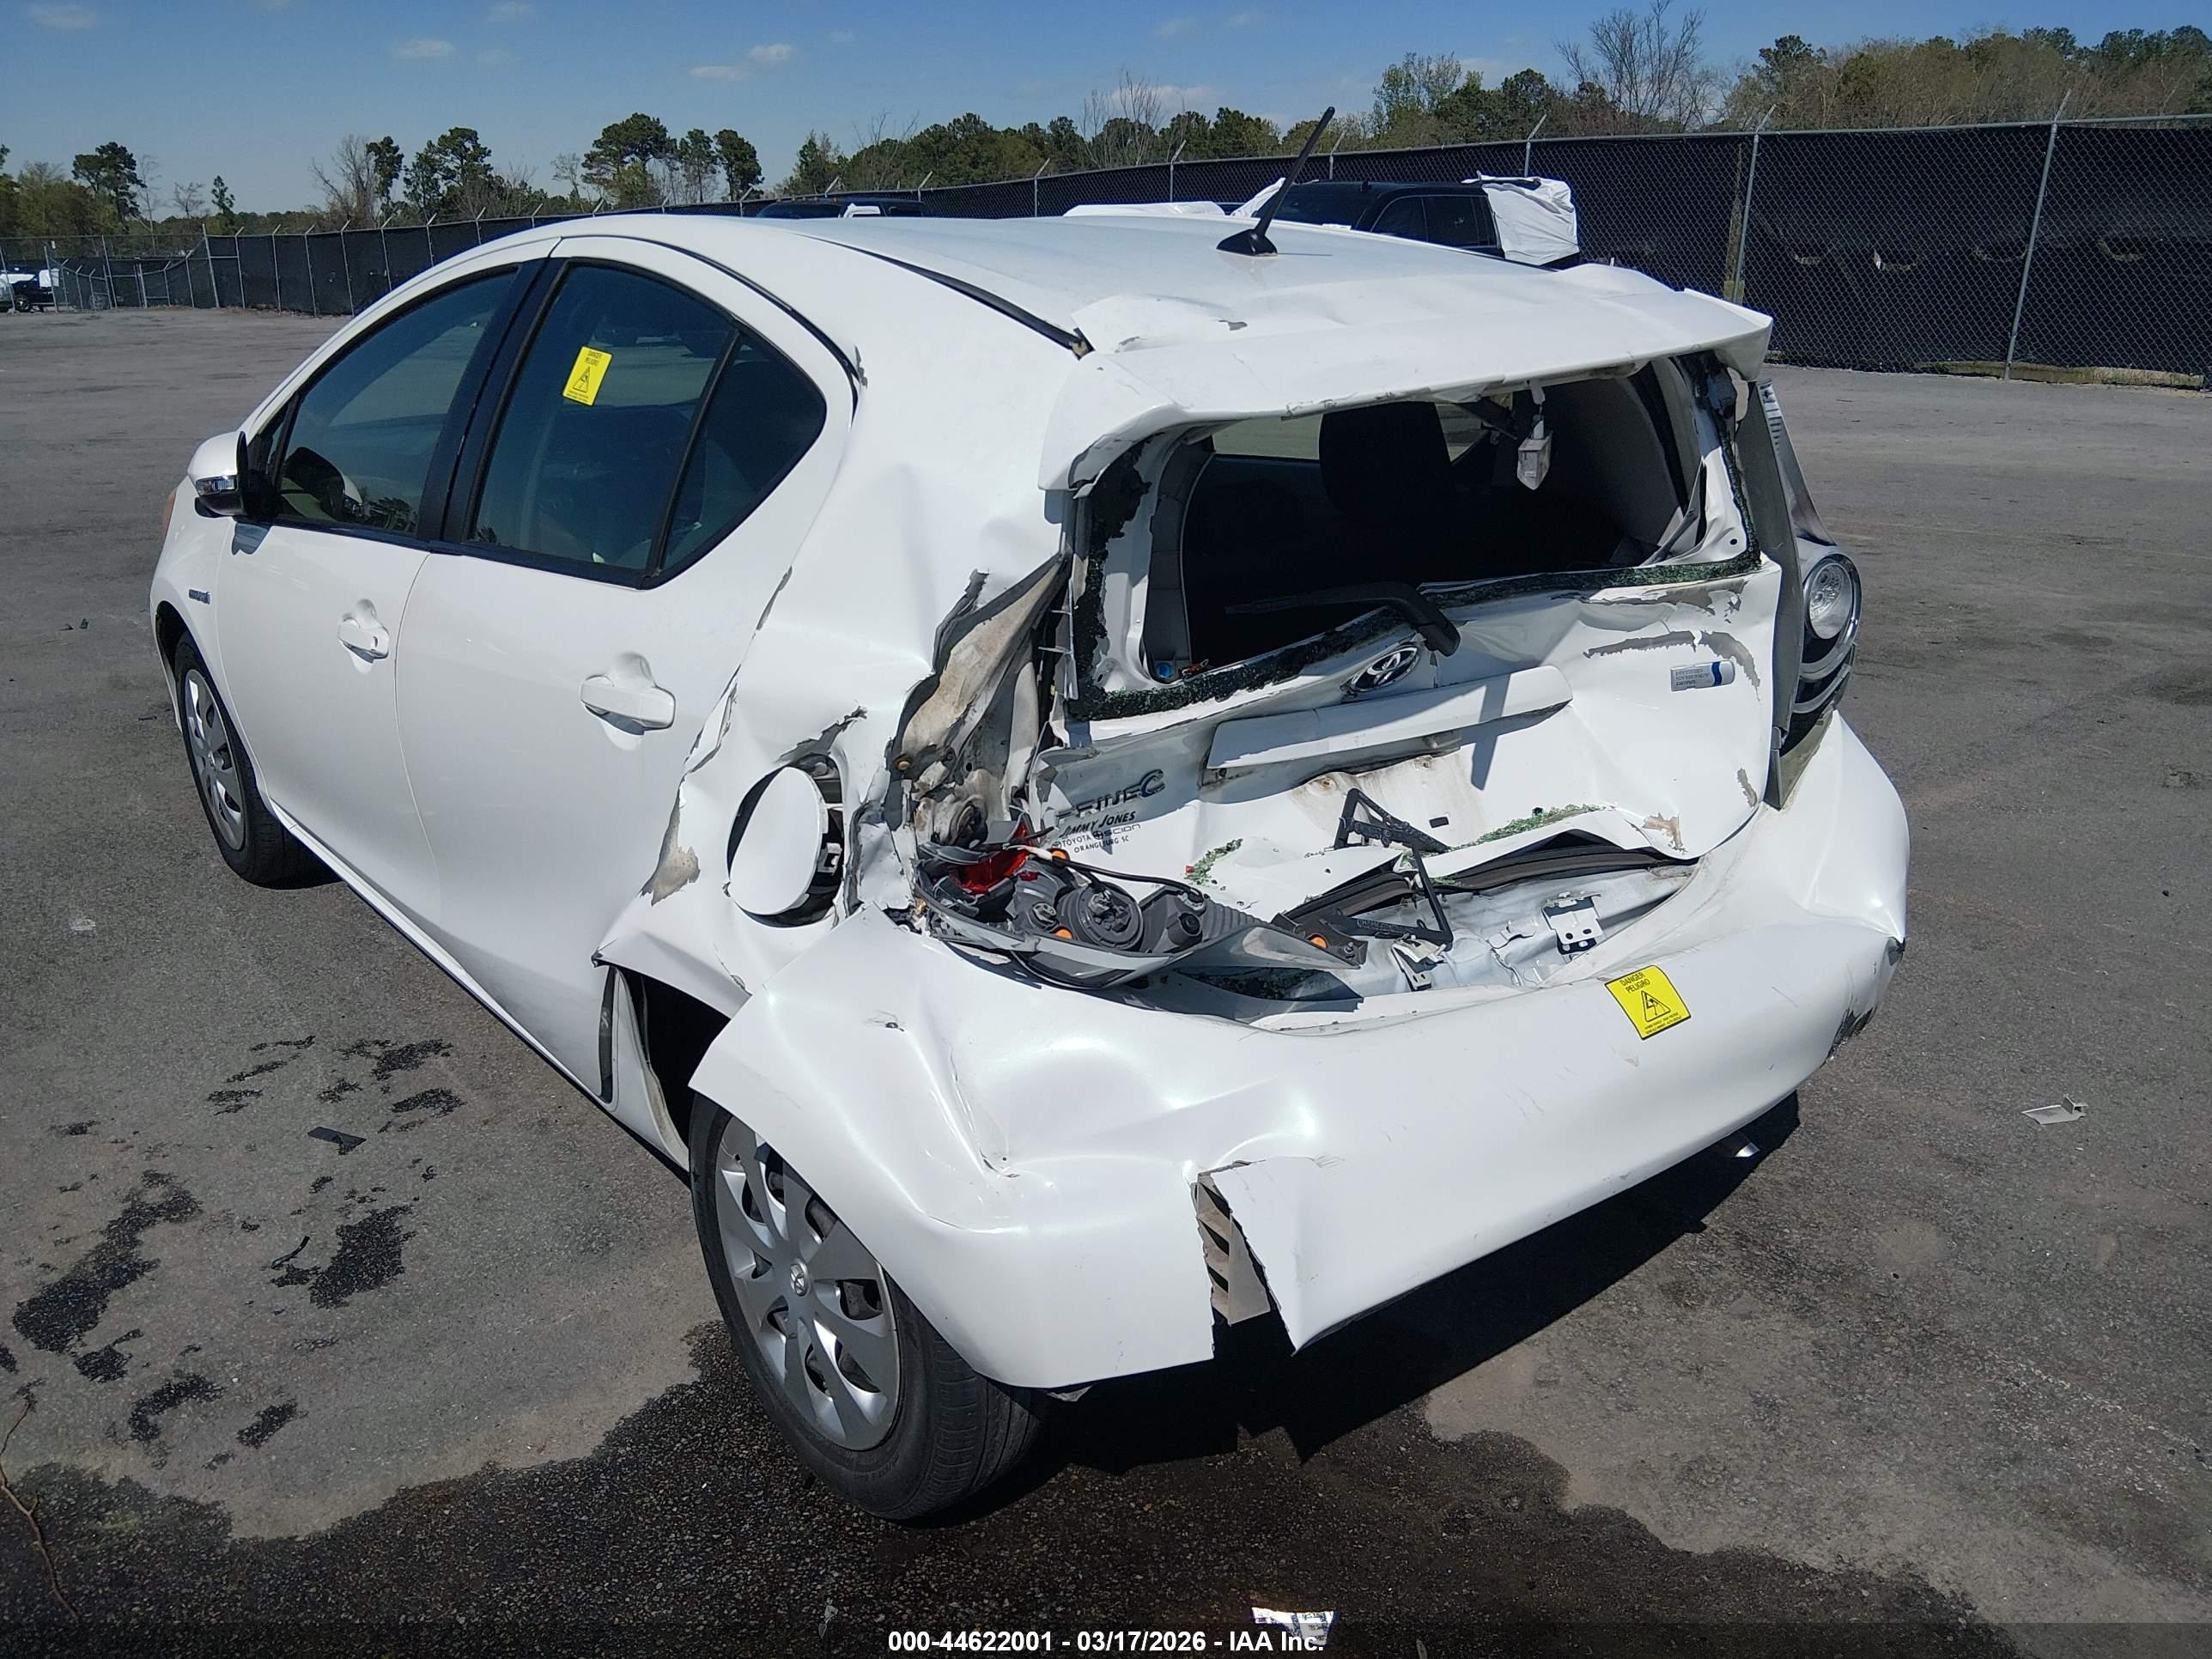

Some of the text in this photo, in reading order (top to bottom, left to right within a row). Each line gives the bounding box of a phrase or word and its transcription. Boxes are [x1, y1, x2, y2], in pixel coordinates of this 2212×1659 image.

[1059, 811, 1136, 838] JIMMY JONES
[1062, 834, 1092, 847] TOYOTA
[1620, 972, 1645, 986] DANGER
[1626, 979, 1650, 993] PELIGRO
